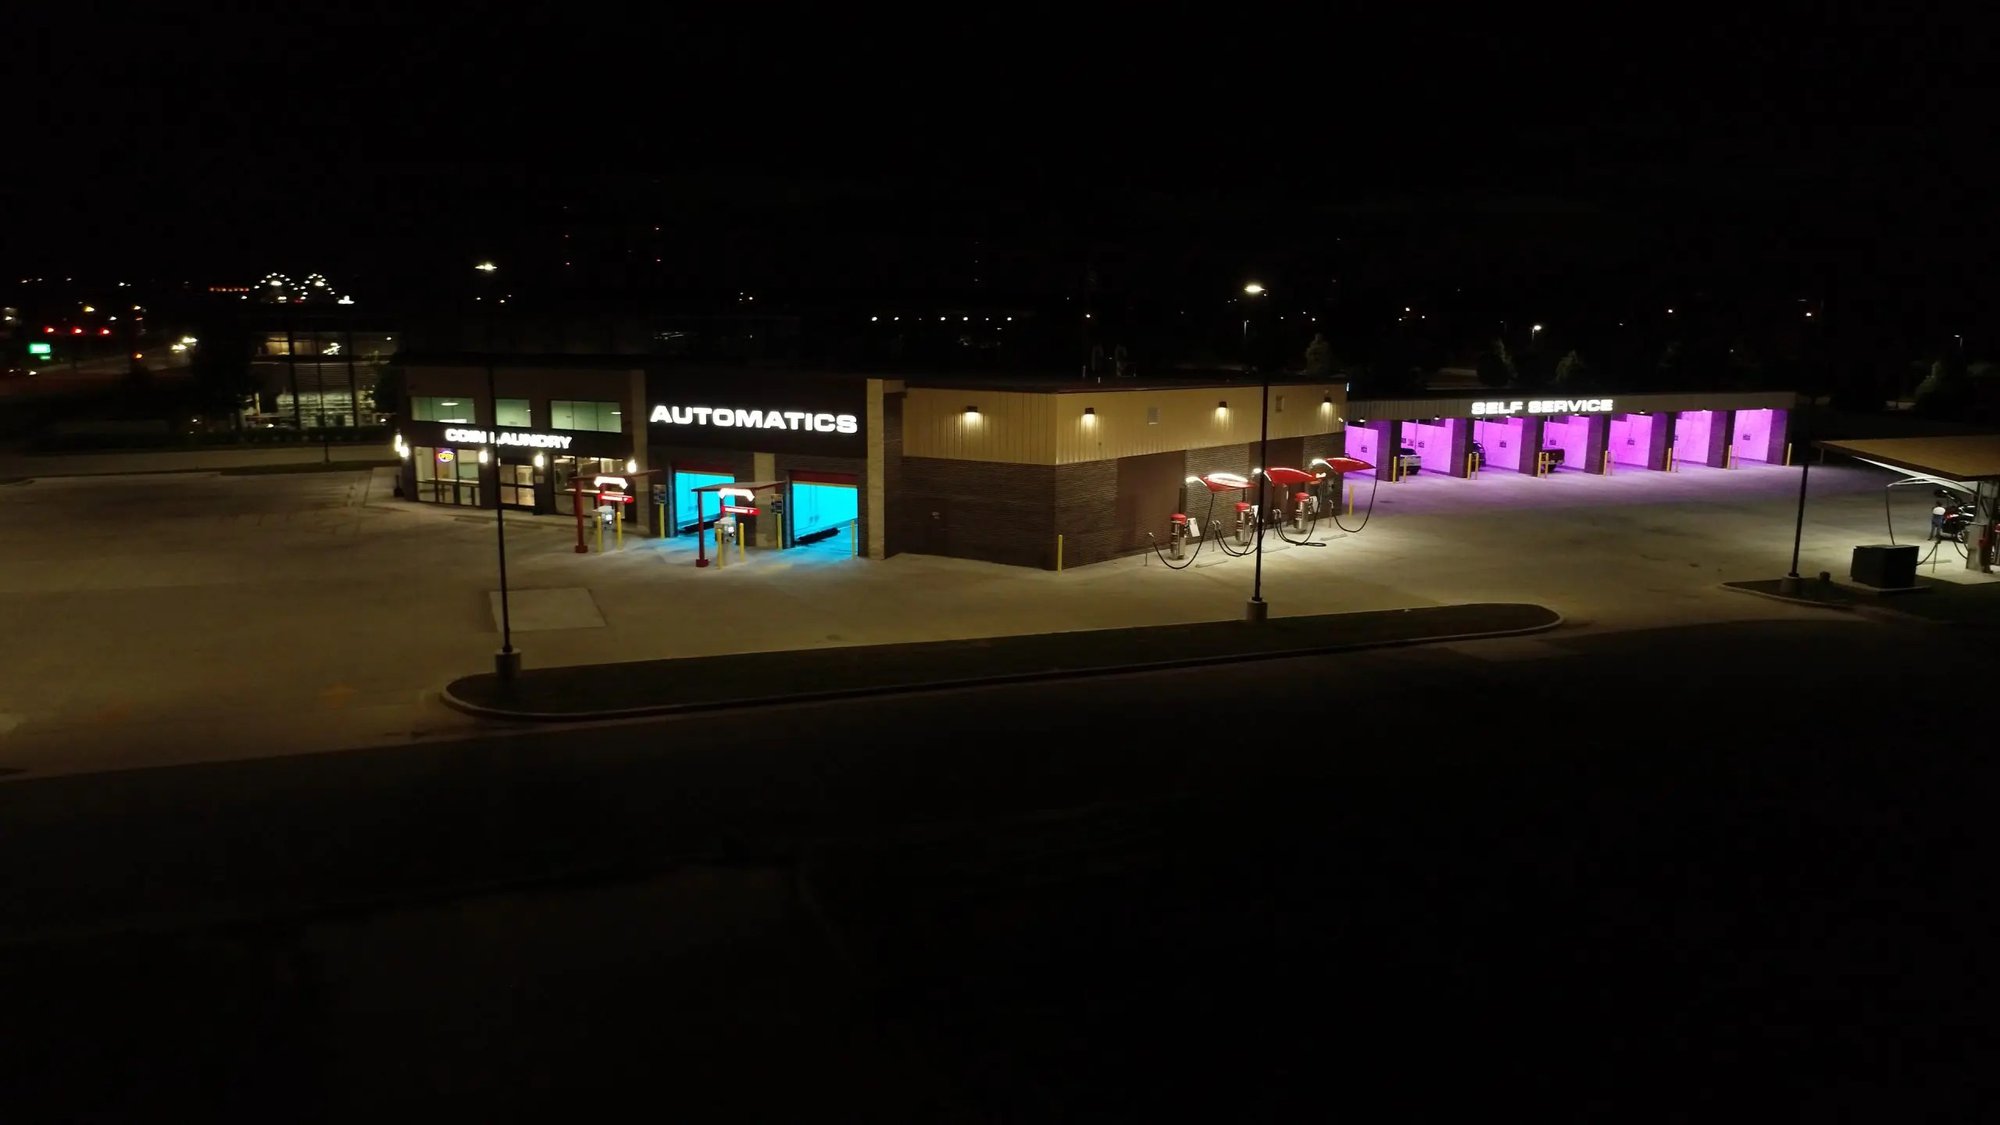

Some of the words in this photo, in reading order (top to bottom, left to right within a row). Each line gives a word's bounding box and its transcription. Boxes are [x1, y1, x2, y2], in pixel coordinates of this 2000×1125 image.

[1471, 401, 1524, 415] SELF
[1528, 399, 1613, 413] SERVICE
[650, 405, 858, 434] AUTOMATICS
[445, 428, 487, 443] COIN
